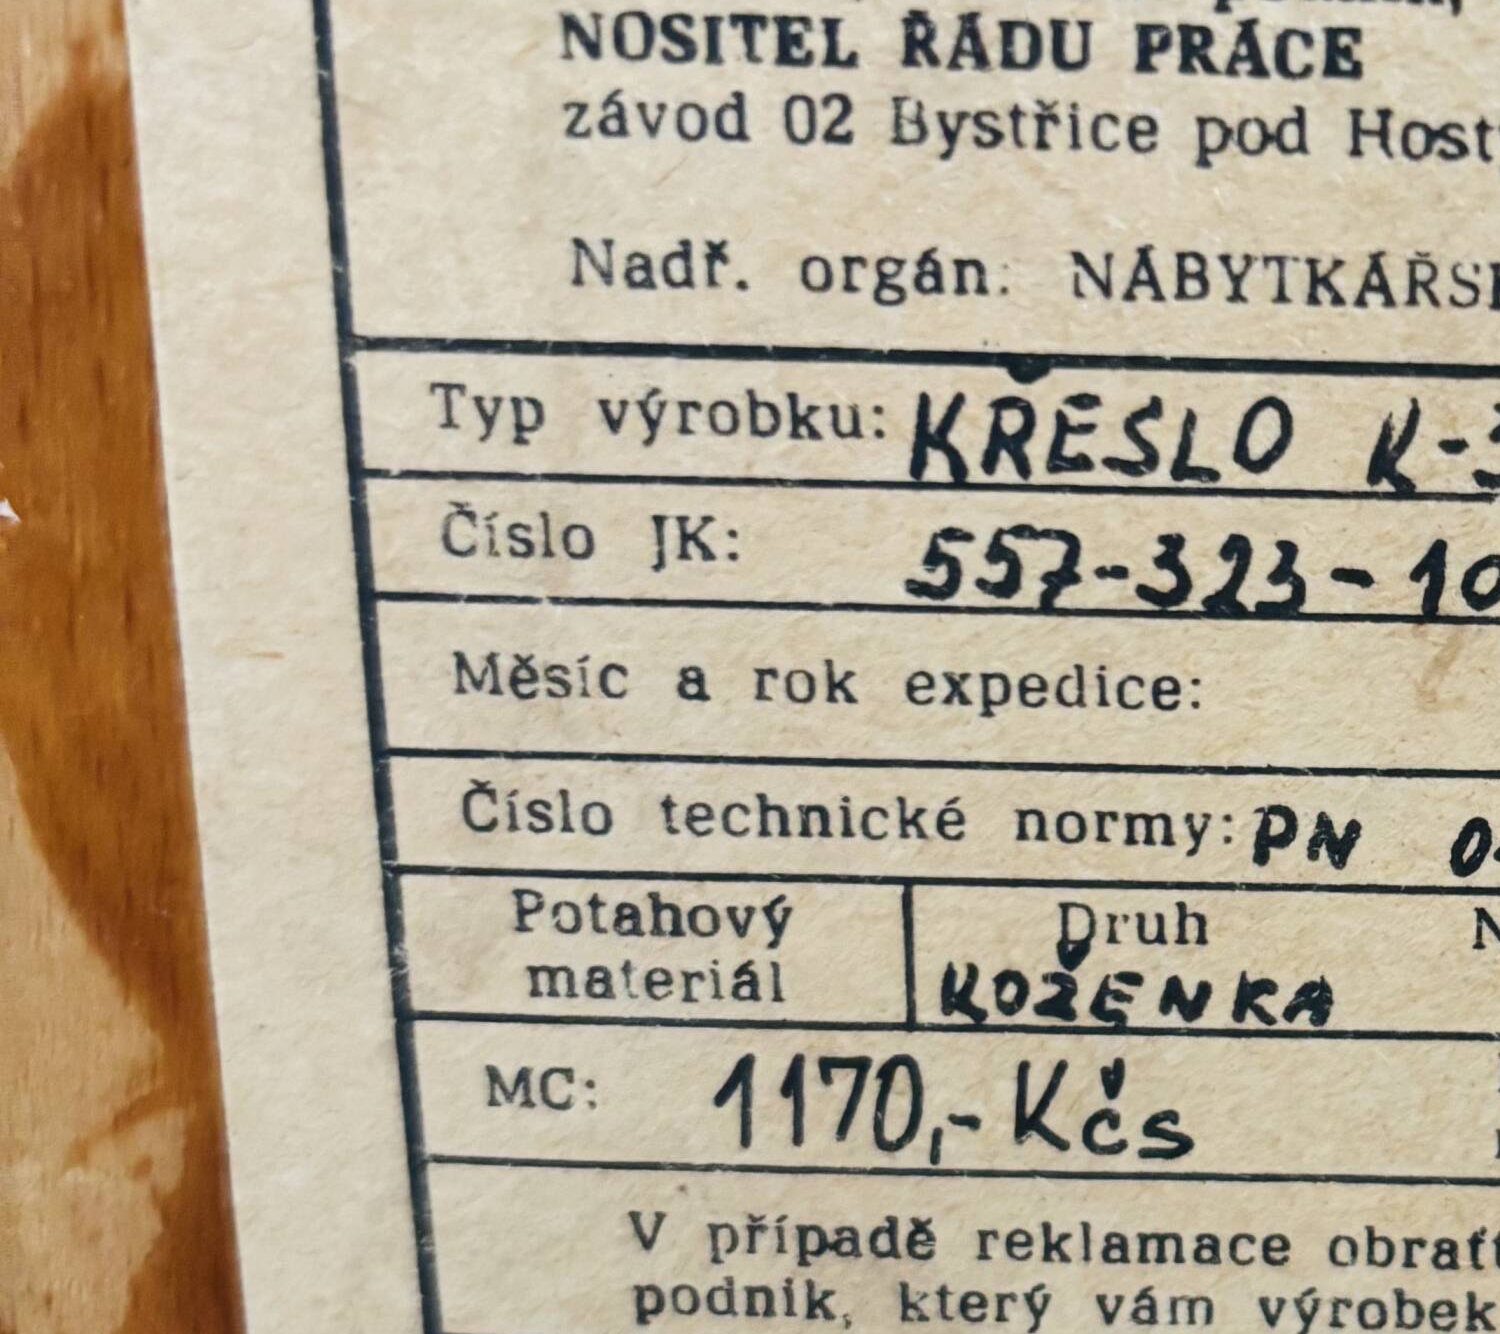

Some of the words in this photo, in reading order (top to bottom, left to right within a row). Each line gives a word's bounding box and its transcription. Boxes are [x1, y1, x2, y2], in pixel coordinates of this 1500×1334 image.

[557, 8, 861, 71] NOSITEL
[898, 7, 1095, 74] ŘÁDU
[1132, 15, 1365, 83] PRÁCE
[561, 87, 752, 144] závod
[781, 91, 856, 148] 02
[888, 93, 1161, 163] Bystřice
[1193, 103, 1311, 171] pod
[569, 235, 751, 293] Nadř.
[798, 245, 1010, 309] orgán:
[427, 380, 547, 448] Typ
[595, 385, 887, 449] výrobku:
[905, 365, 1295, 482] KŘESLO
[439, 499, 597, 562] Číslo
[649, 512, 741, 575] JK:
[451, 649, 630, 703] Měsíc
[674, 664, 713, 704] a
[751, 657, 860, 706] rok
[903, 662, 1203, 720] expedice:
[460, 777, 615, 838] Číslo
[658, 791, 968, 843] technické
[1012, 807, 1234, 859] normy:
[1252, 804, 1362, 869] PN
[509, 886, 795, 951] Potahový
[1054, 899, 1211, 949] Druh
[523, 957, 787, 1005] materiál
[938, 939, 1338, 1029] KOŽENKA
[483, 1063, 598, 1113] MC:
[712, 1051, 984, 1167] 1170,-
[1010, 1057, 1196, 1161] Kčs
[625, 1209, 669, 1253] V
[705, 1211, 938, 1269] případě
[974, 1219, 1293, 1269] reklamace
[630, 1274, 854, 1331] podnik,
[1094, 1284, 1216, 1328] vám
